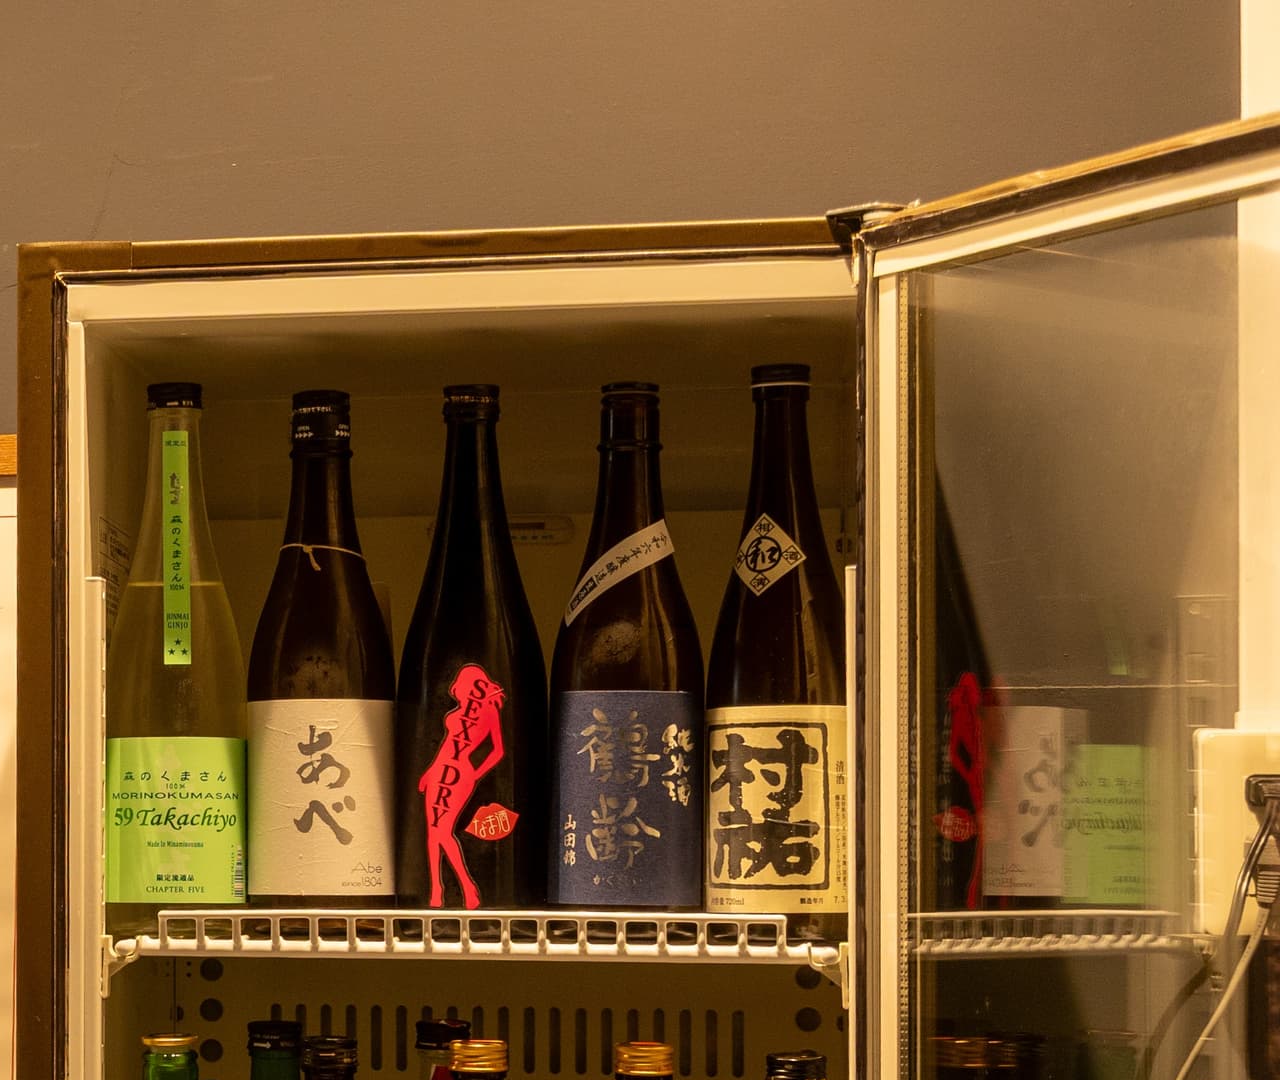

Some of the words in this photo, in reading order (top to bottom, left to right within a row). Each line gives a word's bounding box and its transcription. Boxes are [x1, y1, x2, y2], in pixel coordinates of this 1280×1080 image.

[169, 515, 183, 584] 森のくまさん
[166, 612, 190, 621] JUNMAI
[167, 621, 189, 630] GINJO
[453, 678, 490, 762] SEXY
[123, 771, 228, 782] 森のくまさん
[293, 725, 356, 846] あべ
[661, 723, 695, 807] 純米酒
[112, 792, 240, 800] MORINOKUMASAN
[430, 763, 461, 828] DRY
[710, 728, 821, 880] 村祐
[114, 807, 134, 827] 59
[136, 807, 237, 832] Takachiyo
[471, 809, 512, 839] なま酒
[563, 814, 577, 868] 山田錦
[351, 862, 383, 873] Abe
